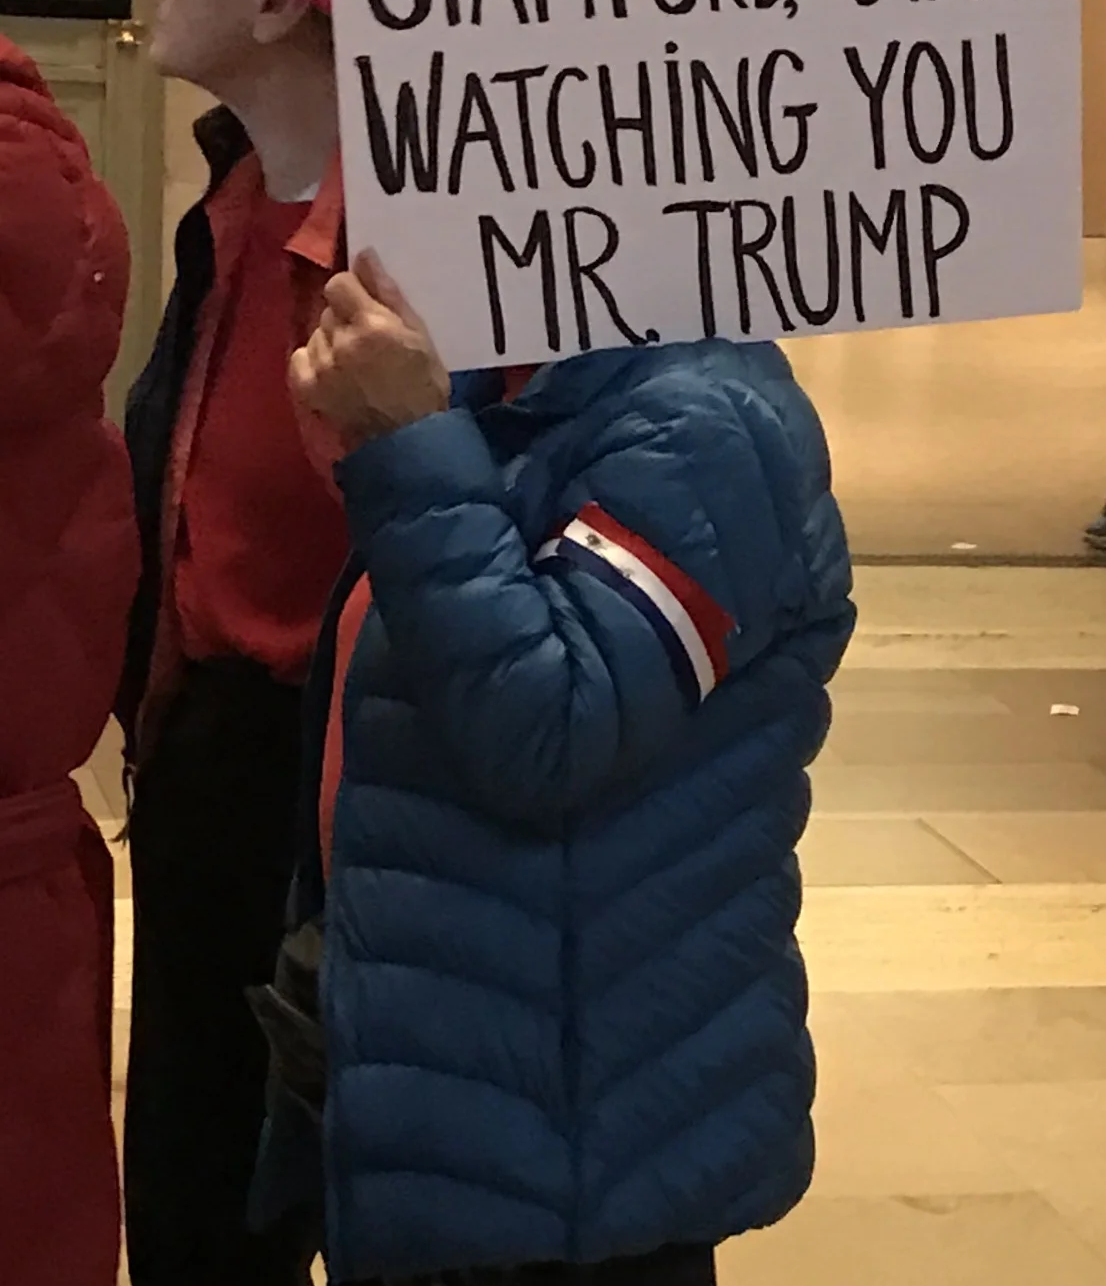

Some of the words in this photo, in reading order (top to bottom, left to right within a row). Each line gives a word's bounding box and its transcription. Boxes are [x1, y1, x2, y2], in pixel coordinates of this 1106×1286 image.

[844, 33, 1014, 170] YOU
[479, 207, 661, 355] MR.
[662, 183, 970, 338] TRUMP
